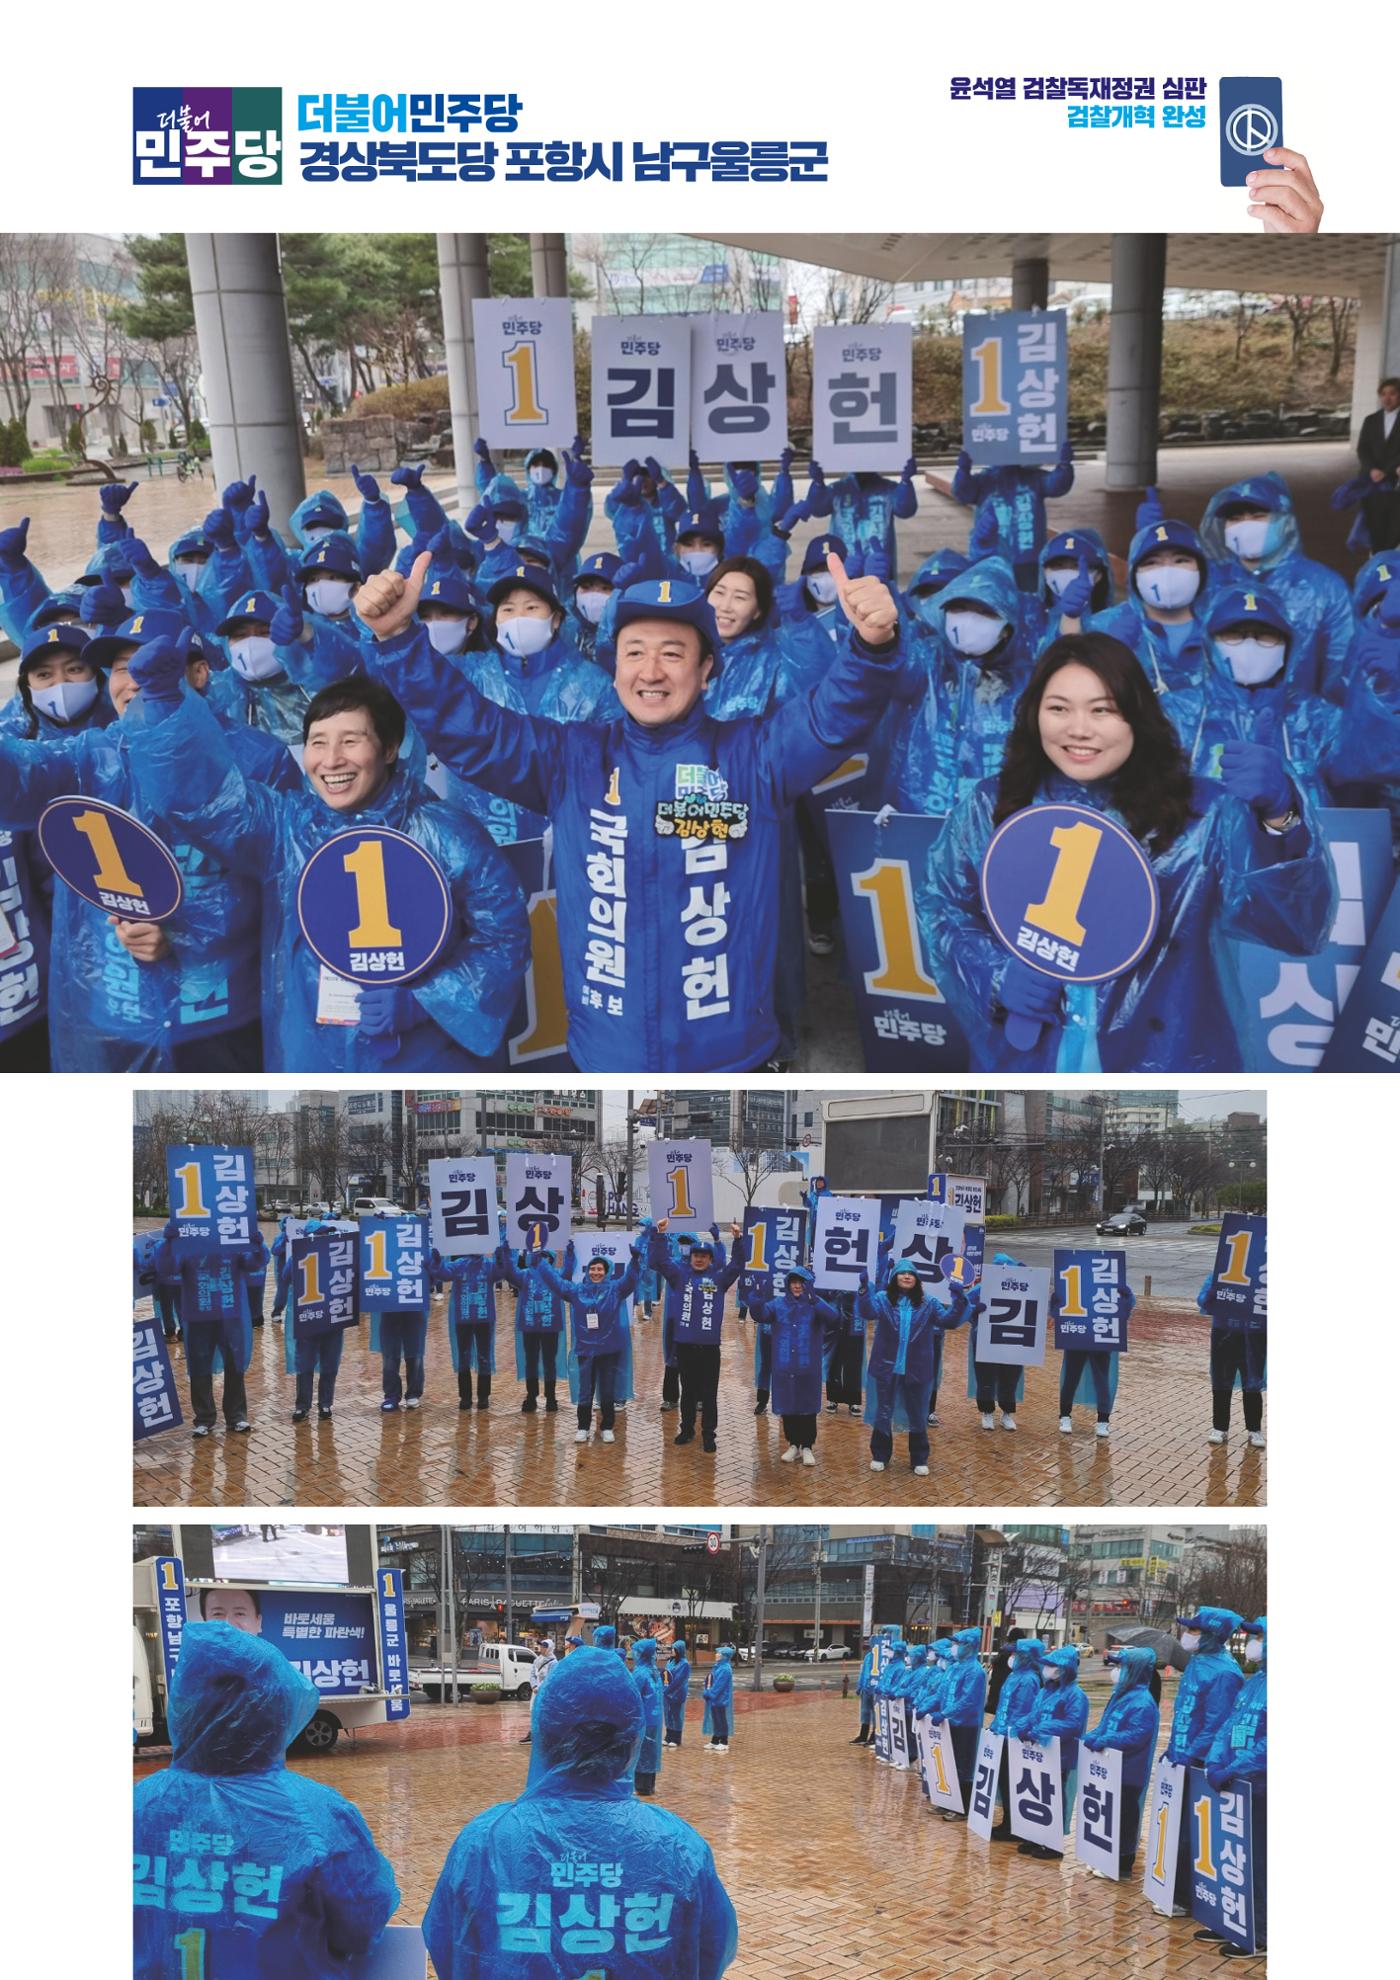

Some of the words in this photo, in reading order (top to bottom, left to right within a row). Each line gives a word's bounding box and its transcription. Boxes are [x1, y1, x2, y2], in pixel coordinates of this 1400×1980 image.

[502, 320, 542, 335] 민주당
[621, 340, 661, 356] 민주당
[716, 336, 756, 352] 민주당
[842, 347, 882, 362] 민주당
[969, 337, 1012, 417] 1
[502, 340, 548, 426] 1
[607, 367, 675, 439] 김
[704, 362, 776, 435] 상
[1016, 322, 1059, 454] 김상헌
[828, 371, 899, 445] 헌
[971, 427, 1009, 443] 민주당
[1156, 526, 1168, 541] 1
[431, 581, 440, 595] 1
[658, 580, 672, 603] 1
[1151, 584, 1160, 601] 1
[1376, 564, 1392, 582] 1
[131, 616, 144, 635] 1
[245, 598, 256, 613] 1
[1244, 593, 1258, 611] 1
[48, 629, 59, 643] 1
[505, 631, 516, 650] 1
[952, 626, 960, 645] 1
[604, 766, 621, 805] 1
[72, 810, 144, 897] 1
[98, 891, 150, 915] 김상헌
[343, 841, 402, 948] 1
[1024, 821, 1102, 947] 1
[850, 858, 946, 1004] 1
[1016, 926, 1080, 972] 김상헌
[350, 952, 405, 971] 김상헌
[873, 1015, 947, 1046] 민주당
[449, 1173, 476, 1183] 민주당
[666, 1153, 693, 1163] 민주당
[174, 1162, 211, 1219] 1
[213, 1154, 250, 1245] 김상헌
[515, 1186, 564, 1233] 상
[666, 1166, 696, 1218] 1
[931, 1176, 941, 1196] 1
[178, 1226, 210, 1237] 민주당
[441, 1189, 489, 1238] 김
[532, 1222, 542, 1248] 1
[836, 1212, 861, 1222] 민주당
[364, 1230, 392, 1280] 1
[396, 1223, 425, 1304] 김상헌
[592, 1247, 616, 1256] 민주당
[745, 1222, 769, 1272] 1
[824, 1226, 874, 1273] 헌
[901, 1234, 954, 1283] 상
[950, 1256, 964, 1280] 1
[1218, 1230, 1253, 1286] 1
[298, 1252, 325, 1306] 1
[328, 1240, 355, 1324] 김상헌
[1059, 1265, 1088, 1317] 1
[1091, 1258, 1120, 1344] 김상헌
[989, 1298, 1038, 1348] 김
[133, 1328, 174, 1428] 김상헌
[161, 1562, 179, 1590] 1
[383, 1573, 396, 1597] 1
[281, 1626, 322, 1639] 특별한
[324, 1627, 365, 1639] 파란색!
[283, 1612, 335, 1625] 바로세움
[872, 1644, 880, 1676] 1
[931, 1743, 952, 1797] 1
[974, 1764, 995, 1819] 김
[1016, 1767, 1056, 1827] 상
[1083, 1783, 1114, 1854] 헌
[169, 1829, 234, 1856] 민주당
[1152, 1801, 1169, 1887] 1
[1193, 1794, 1218, 1882] 1
[133, 1854, 284, 1920] 김상헌
[551, 1862, 624, 1888] 민주당
[1219, 1791, 1247, 1938] 김상헌
[496, 1892, 675, 1954] 김상헌
[174, 1928, 206, 1980] 1
